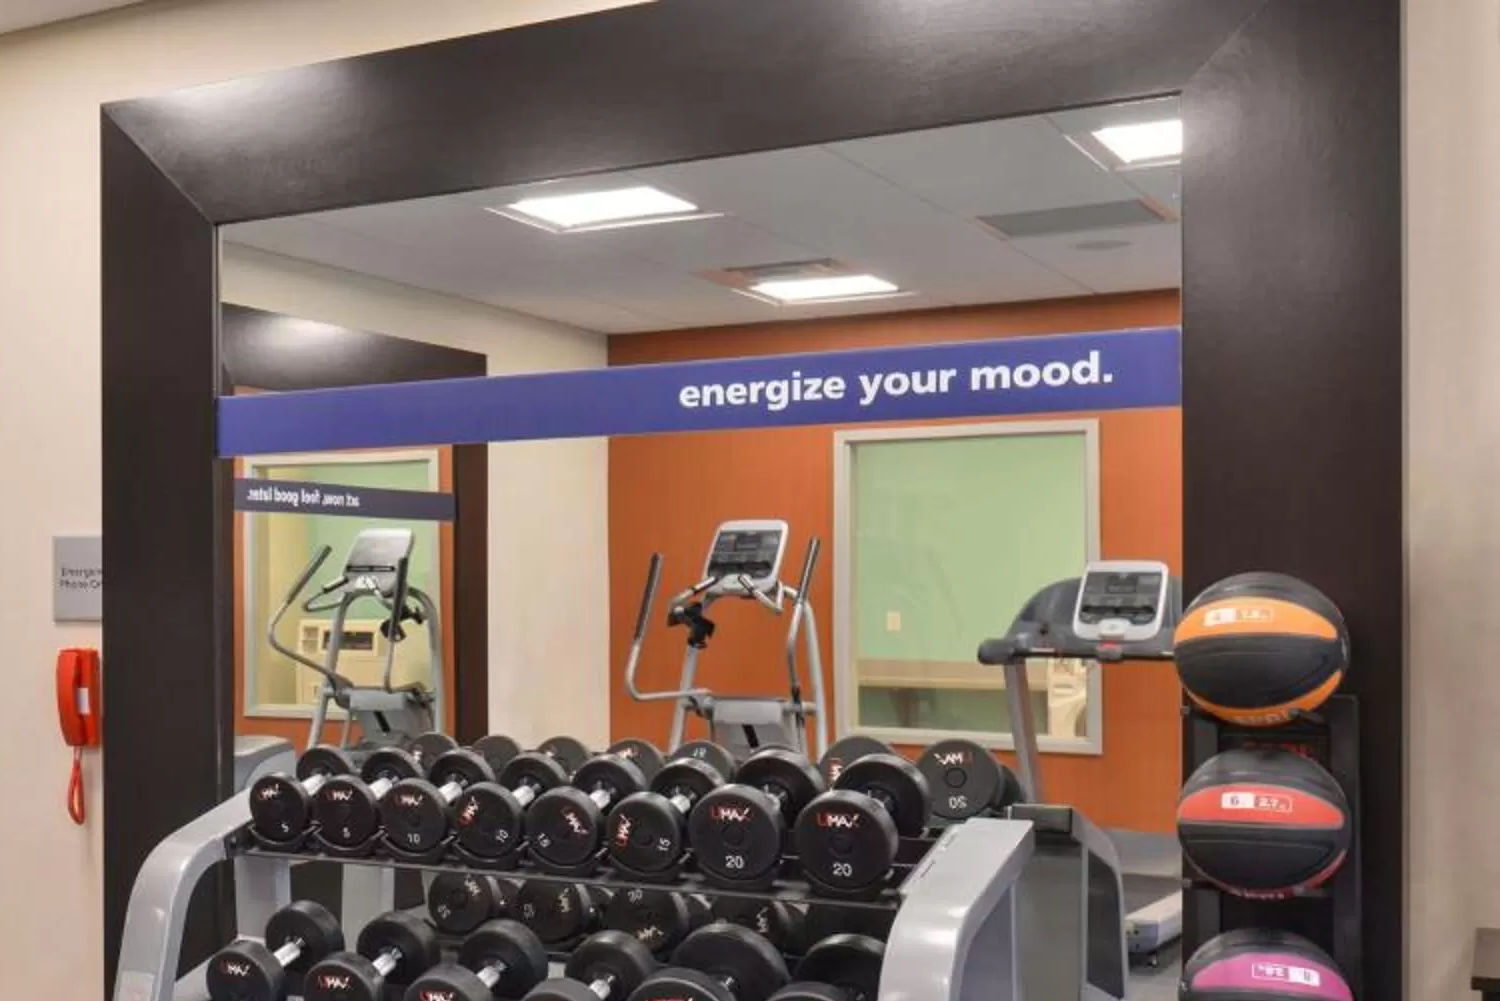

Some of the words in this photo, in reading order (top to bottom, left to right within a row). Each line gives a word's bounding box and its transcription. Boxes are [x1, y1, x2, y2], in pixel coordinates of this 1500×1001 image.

[679, 371, 846, 411] energize
[859, 367, 957, 406] your
[971, 350, 1113, 391] mood.
[407, 832, 421, 845] 10
[724, 855, 745, 870] 20
[832, 861, 853, 877] 20
